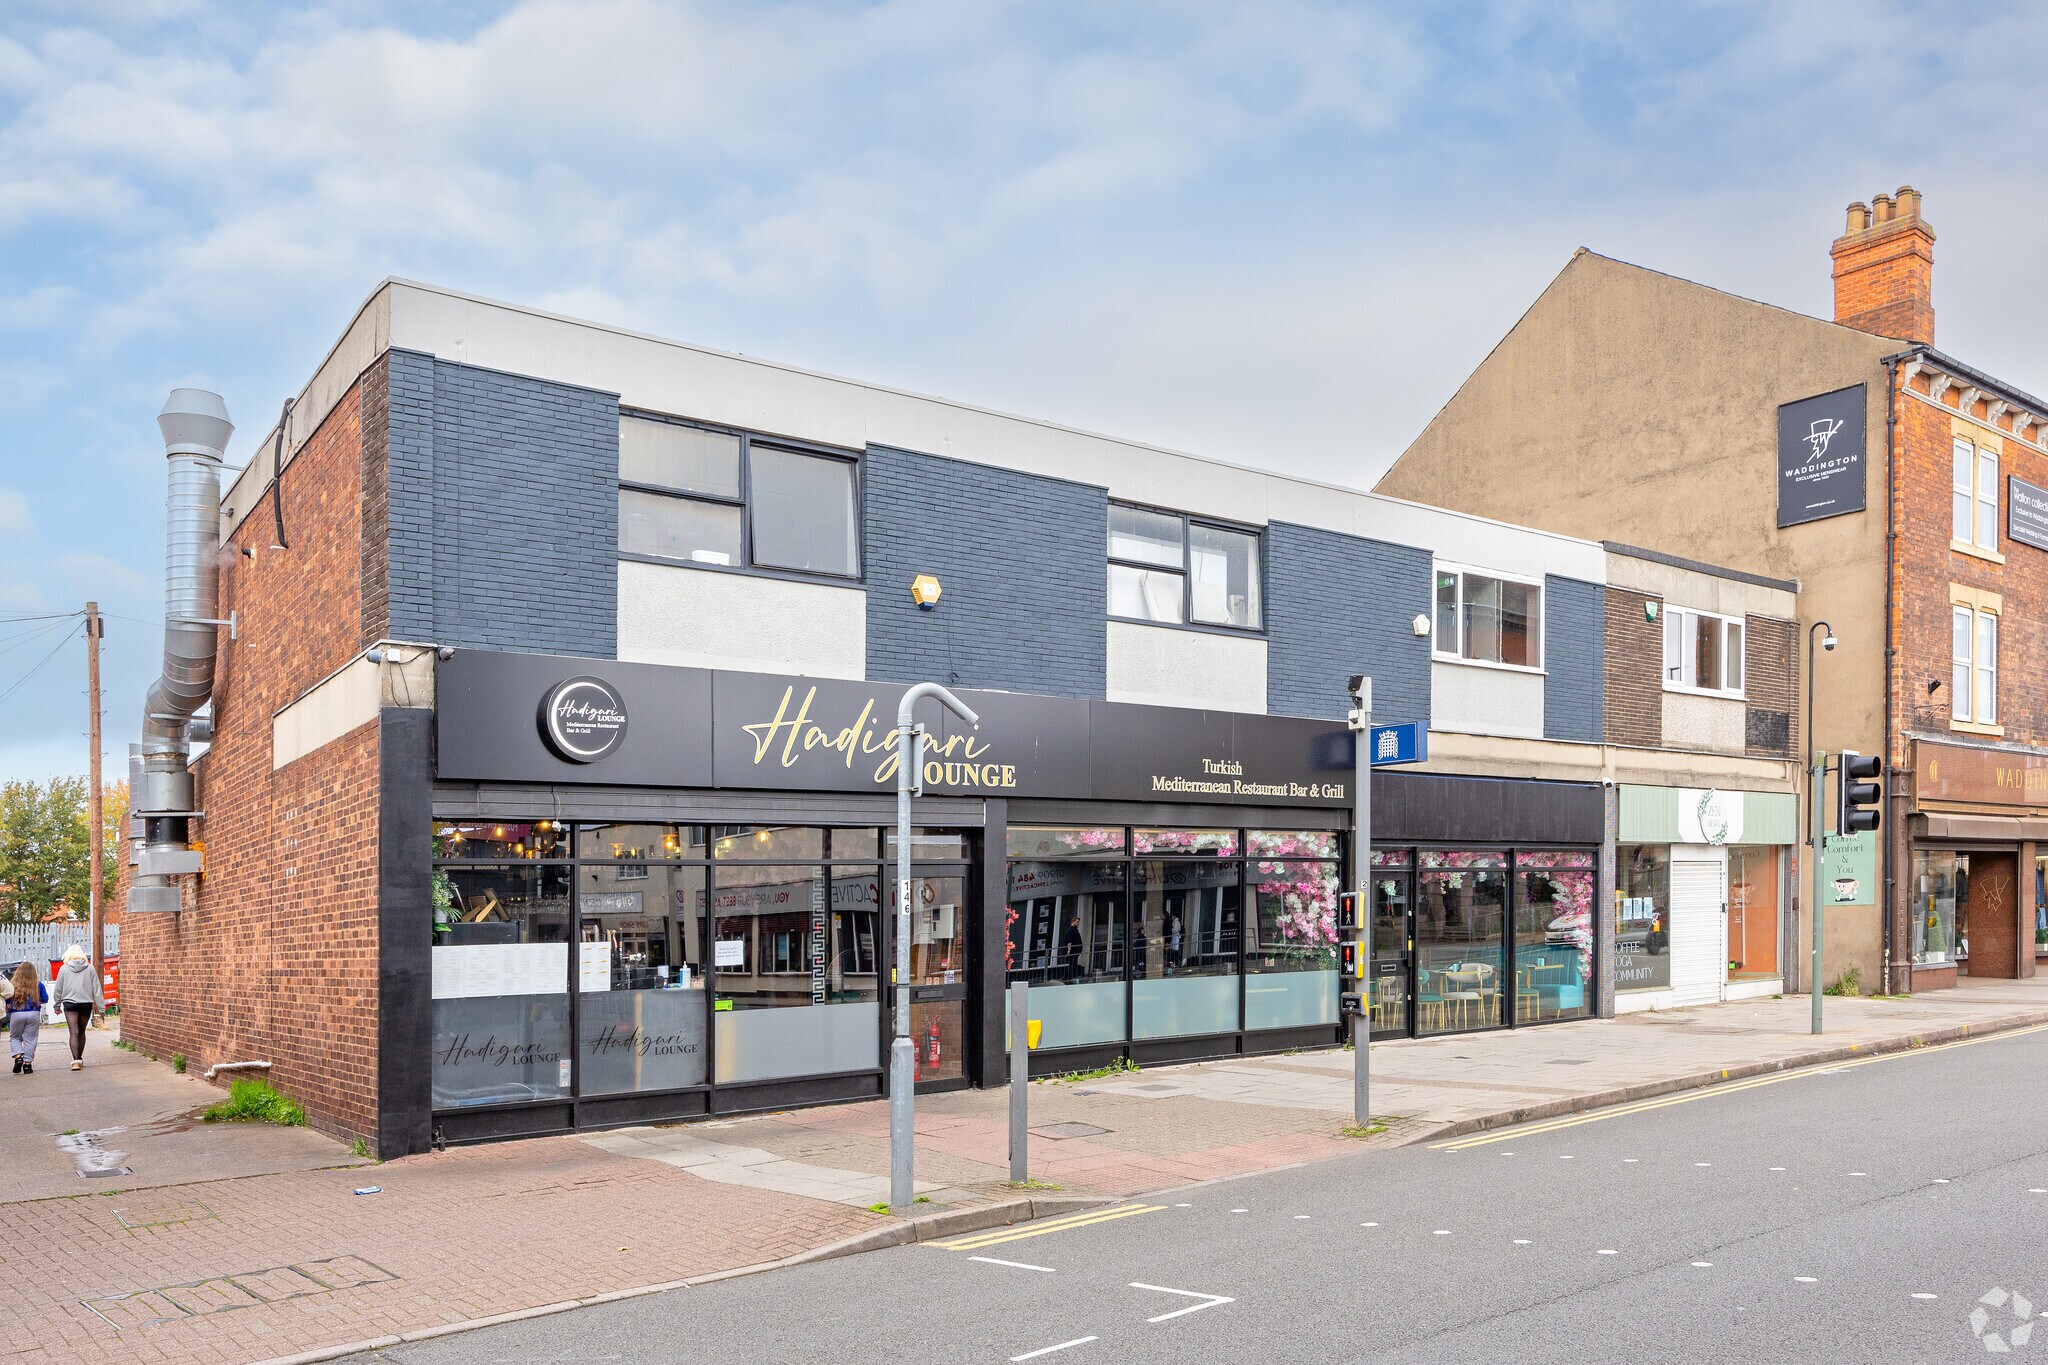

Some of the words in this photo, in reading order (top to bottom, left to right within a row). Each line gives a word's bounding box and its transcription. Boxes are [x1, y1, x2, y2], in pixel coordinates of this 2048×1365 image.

[1785, 455, 1857, 477] WADDINGTON
[558, 700, 618, 721] Hadigari
[597, 715, 626, 723] LOUNGE
[924, 761, 1017, 787] OUNGE
[1202, 758, 1243, 776] Turkish
[1151, 775, 1231, 794] Mediterranean
[1233, 779, 1288, 796] Restaurant
[1289, 782, 1308, 797] Bar
[1309, 784, 1320, 798] &
[1321, 784, 1345, 799] Grill
[1827, 844, 1863, 853] Comfort
[1841, 855, 1848, 864] &
[1837, 865, 1854, 874] You
[1615, 941, 1641, 954] OFFEE
[1615, 955, 1633, 967] OGA
[1615, 966, 1654, 981] OMMUNITY
[588, 1025, 686, 1057] Hadigari
[438, 1033, 548, 1067] Hadigari
[654, 1044, 699, 1056] LOUNGE
[512, 1052, 562, 1066] LOUNGE
